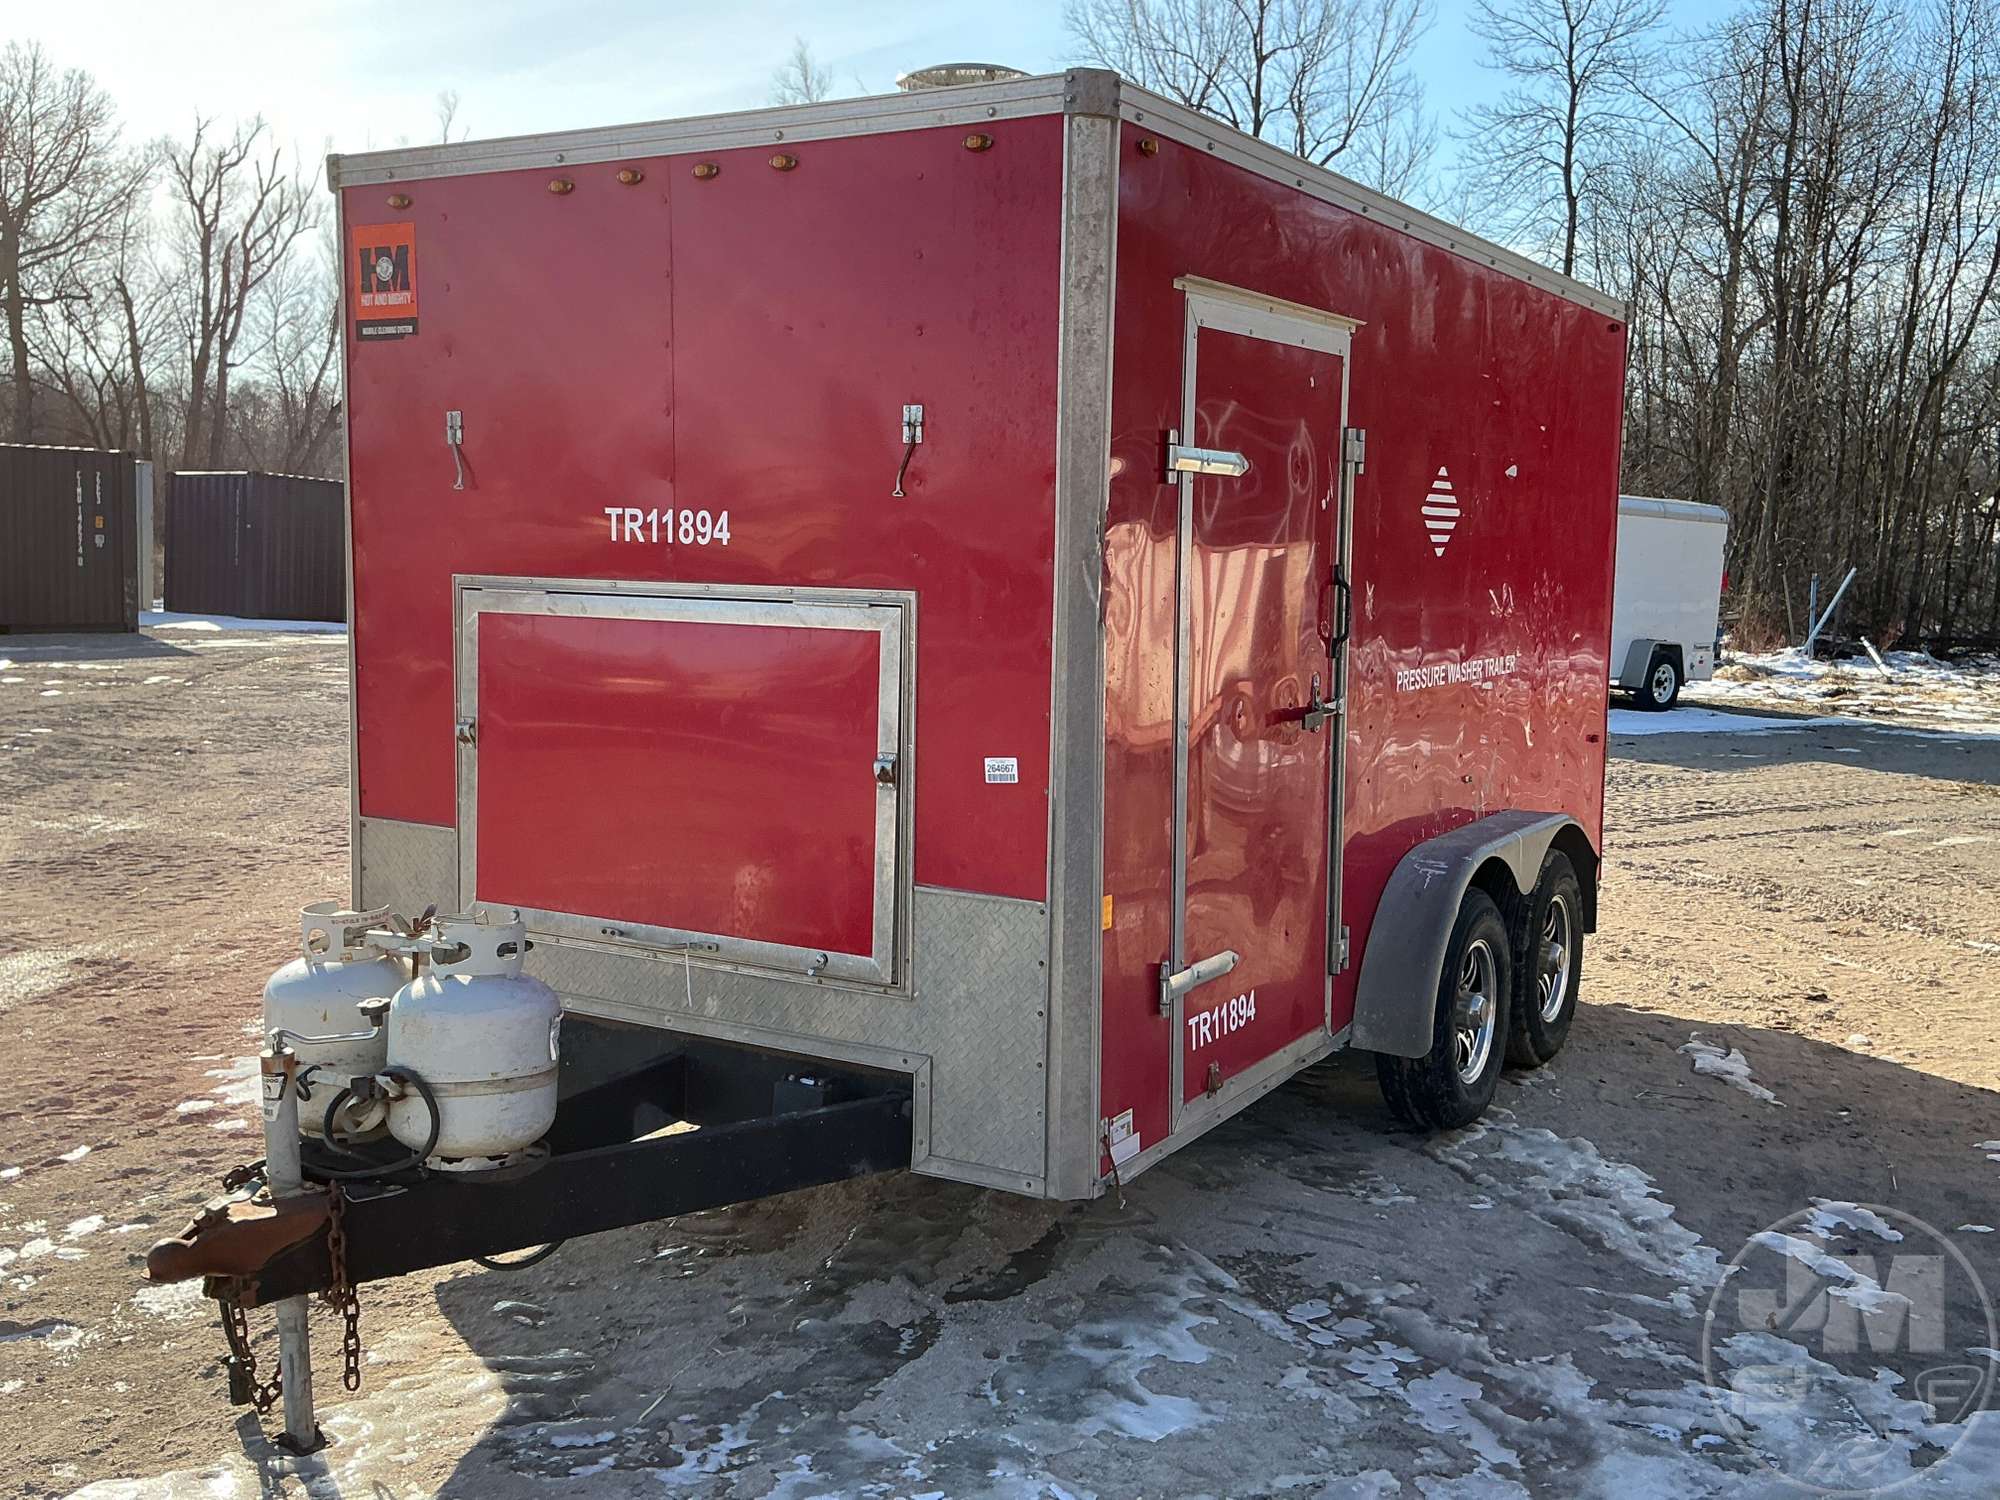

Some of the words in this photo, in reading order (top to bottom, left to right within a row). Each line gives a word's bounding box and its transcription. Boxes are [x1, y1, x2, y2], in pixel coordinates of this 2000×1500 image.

[360, 294, 373, 306] HOT
[375, 293, 388, 306] AND
[388, 292, 411, 305] MIGHTY
[604, 507, 731, 546] TR11894
[1396, 665, 1446, 692] PRESSURE
[1447, 659, 1483, 683] WASHER
[1484, 655, 1517, 677] TRAILER
[1188, 989, 1256, 1051] TR11894
